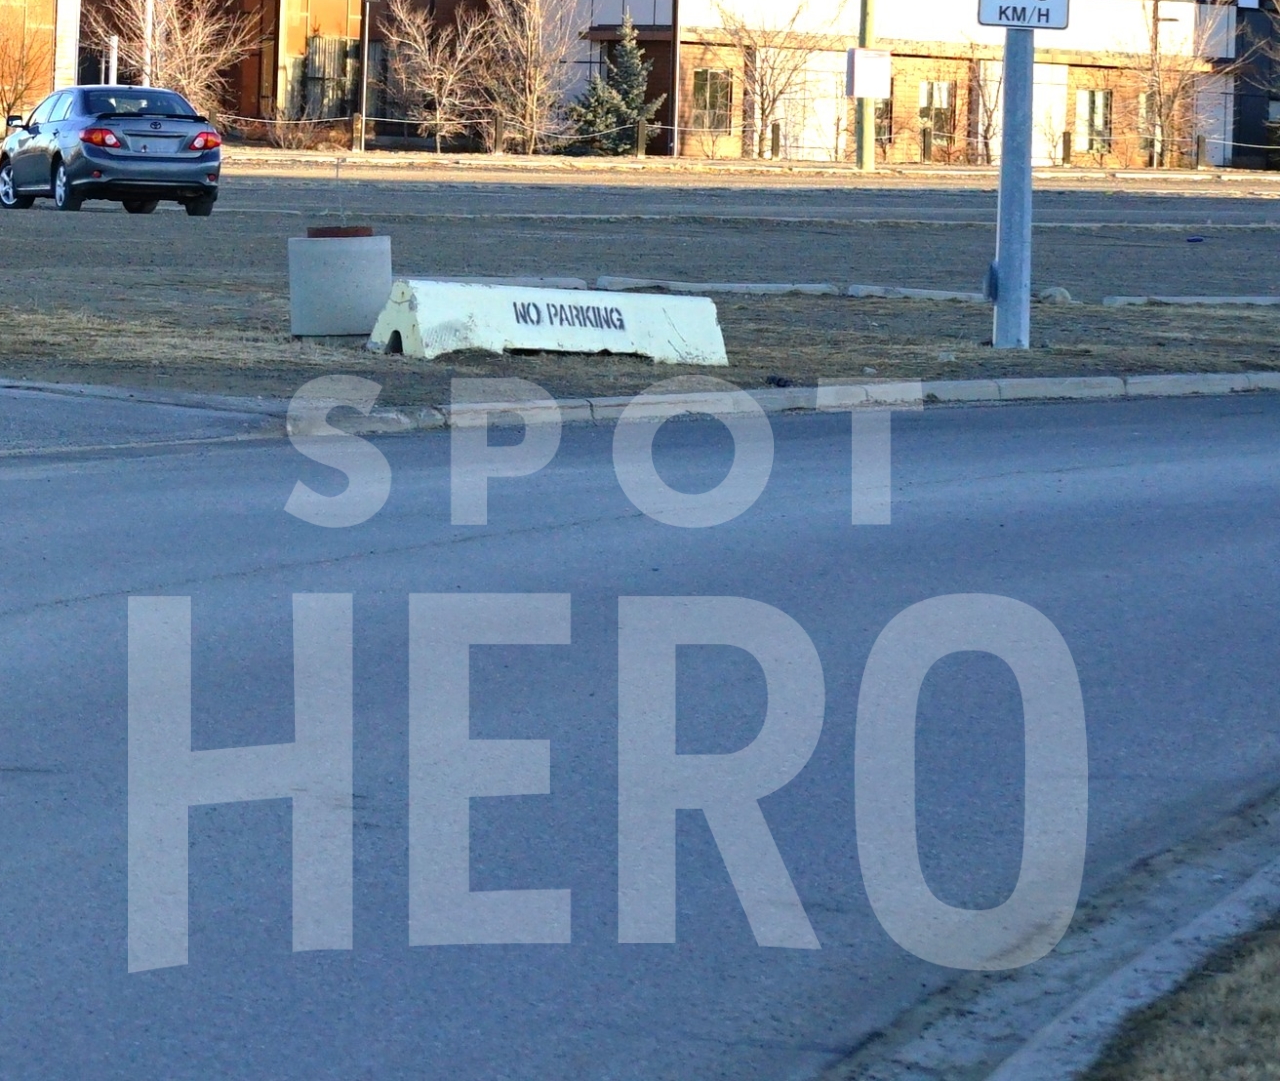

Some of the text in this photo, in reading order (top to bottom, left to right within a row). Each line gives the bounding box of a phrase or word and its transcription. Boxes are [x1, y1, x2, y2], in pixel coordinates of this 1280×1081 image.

[998, 5, 1050, 24] KM/H
[513, 301, 625, 330] NO PARKING
